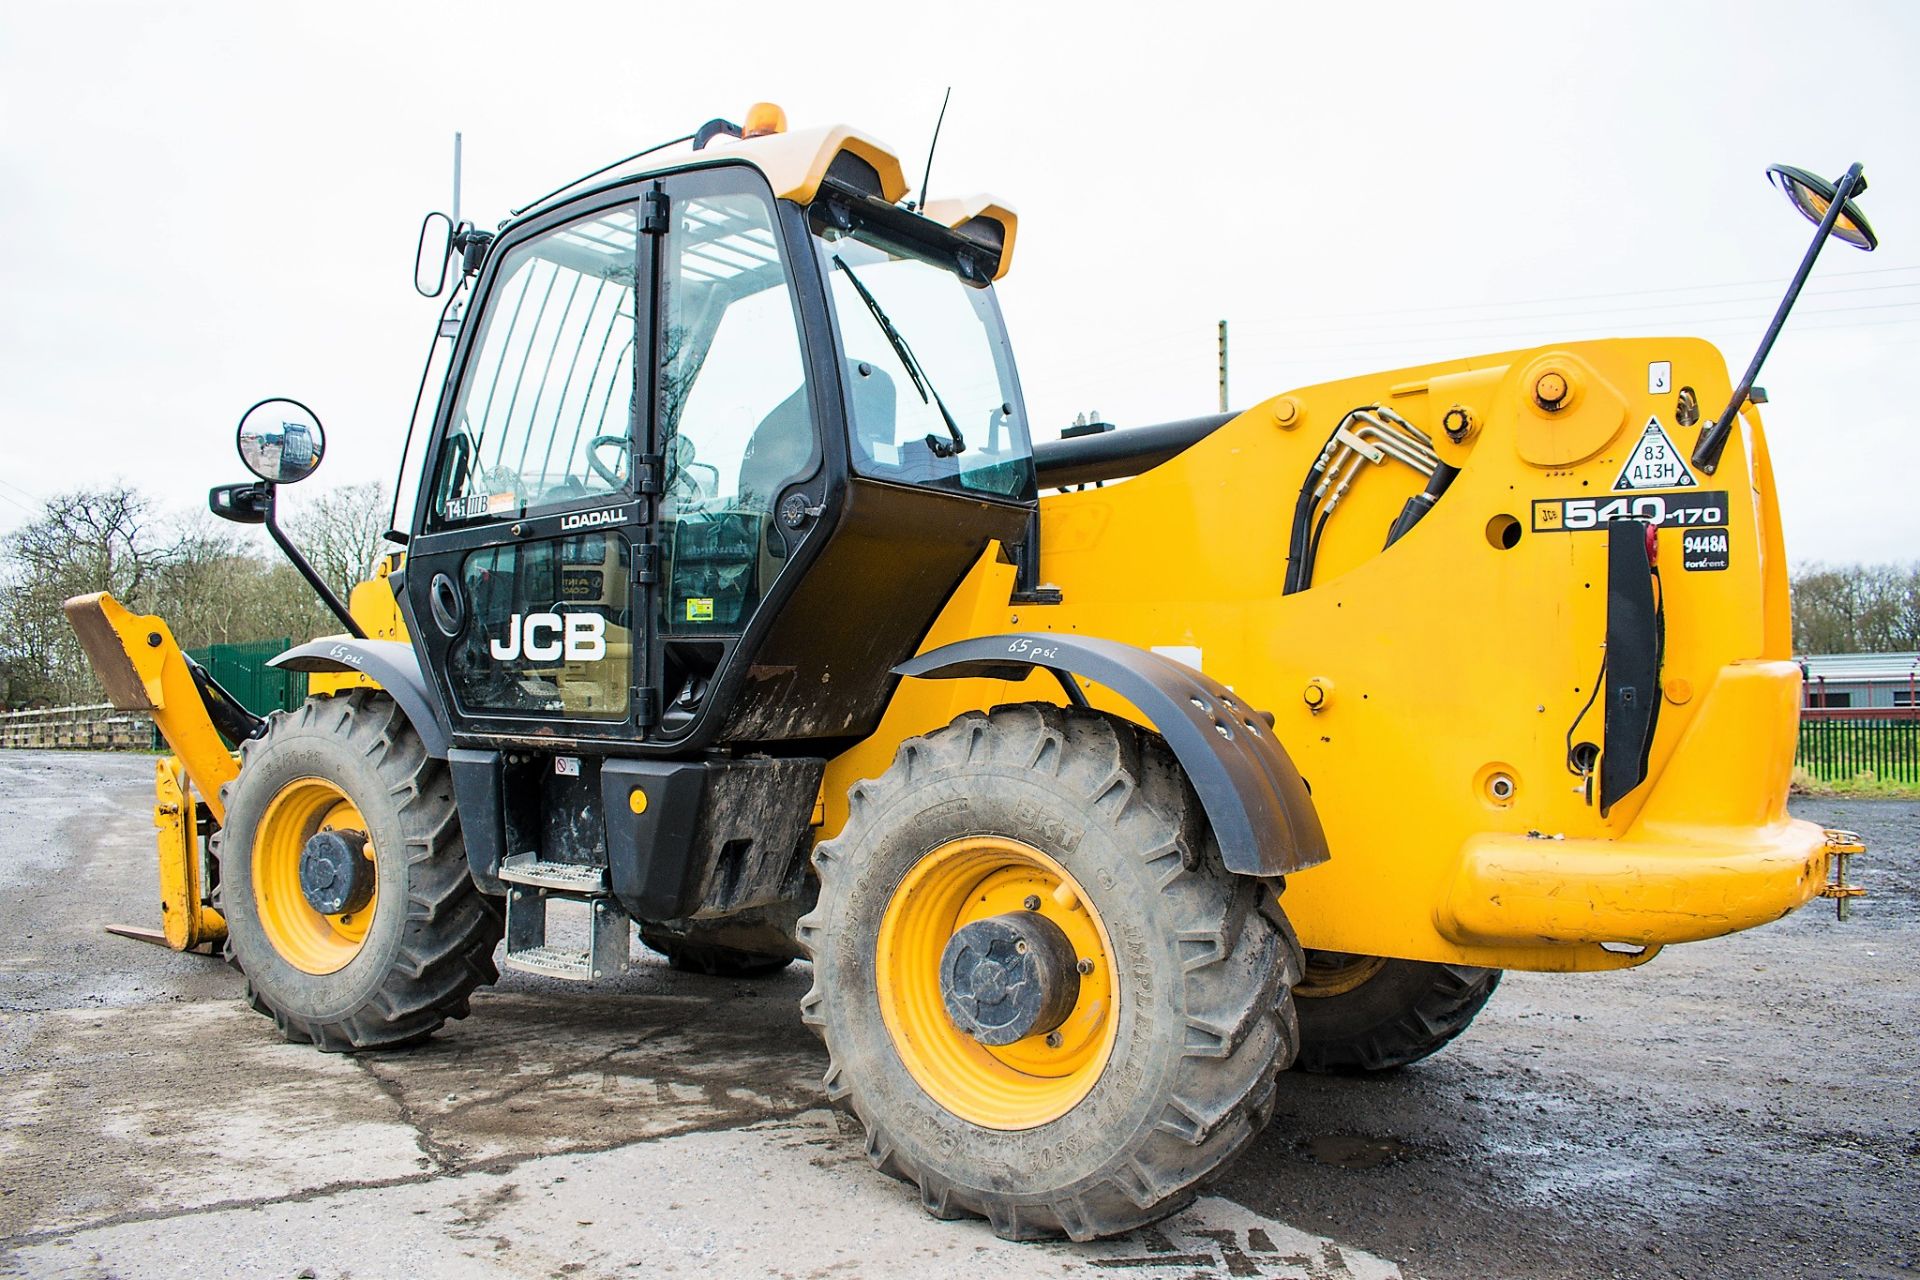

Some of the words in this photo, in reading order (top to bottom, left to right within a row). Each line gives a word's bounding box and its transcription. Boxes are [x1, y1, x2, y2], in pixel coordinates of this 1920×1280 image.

[1644, 445, 1664, 460] 83
[446, 500, 466, 518] T4i
[1542, 509, 1558, 522] JCB
[561, 508, 628, 531] LOADALL
[1684, 535, 1727, 554] 9448A
[490, 612, 606, 661] JCB
[330, 644, 349, 657] 65
[1008, 638, 1033, 653] 65
[1029, 647, 1058, 659] psi
[1014, 801, 1084, 853] BKT
